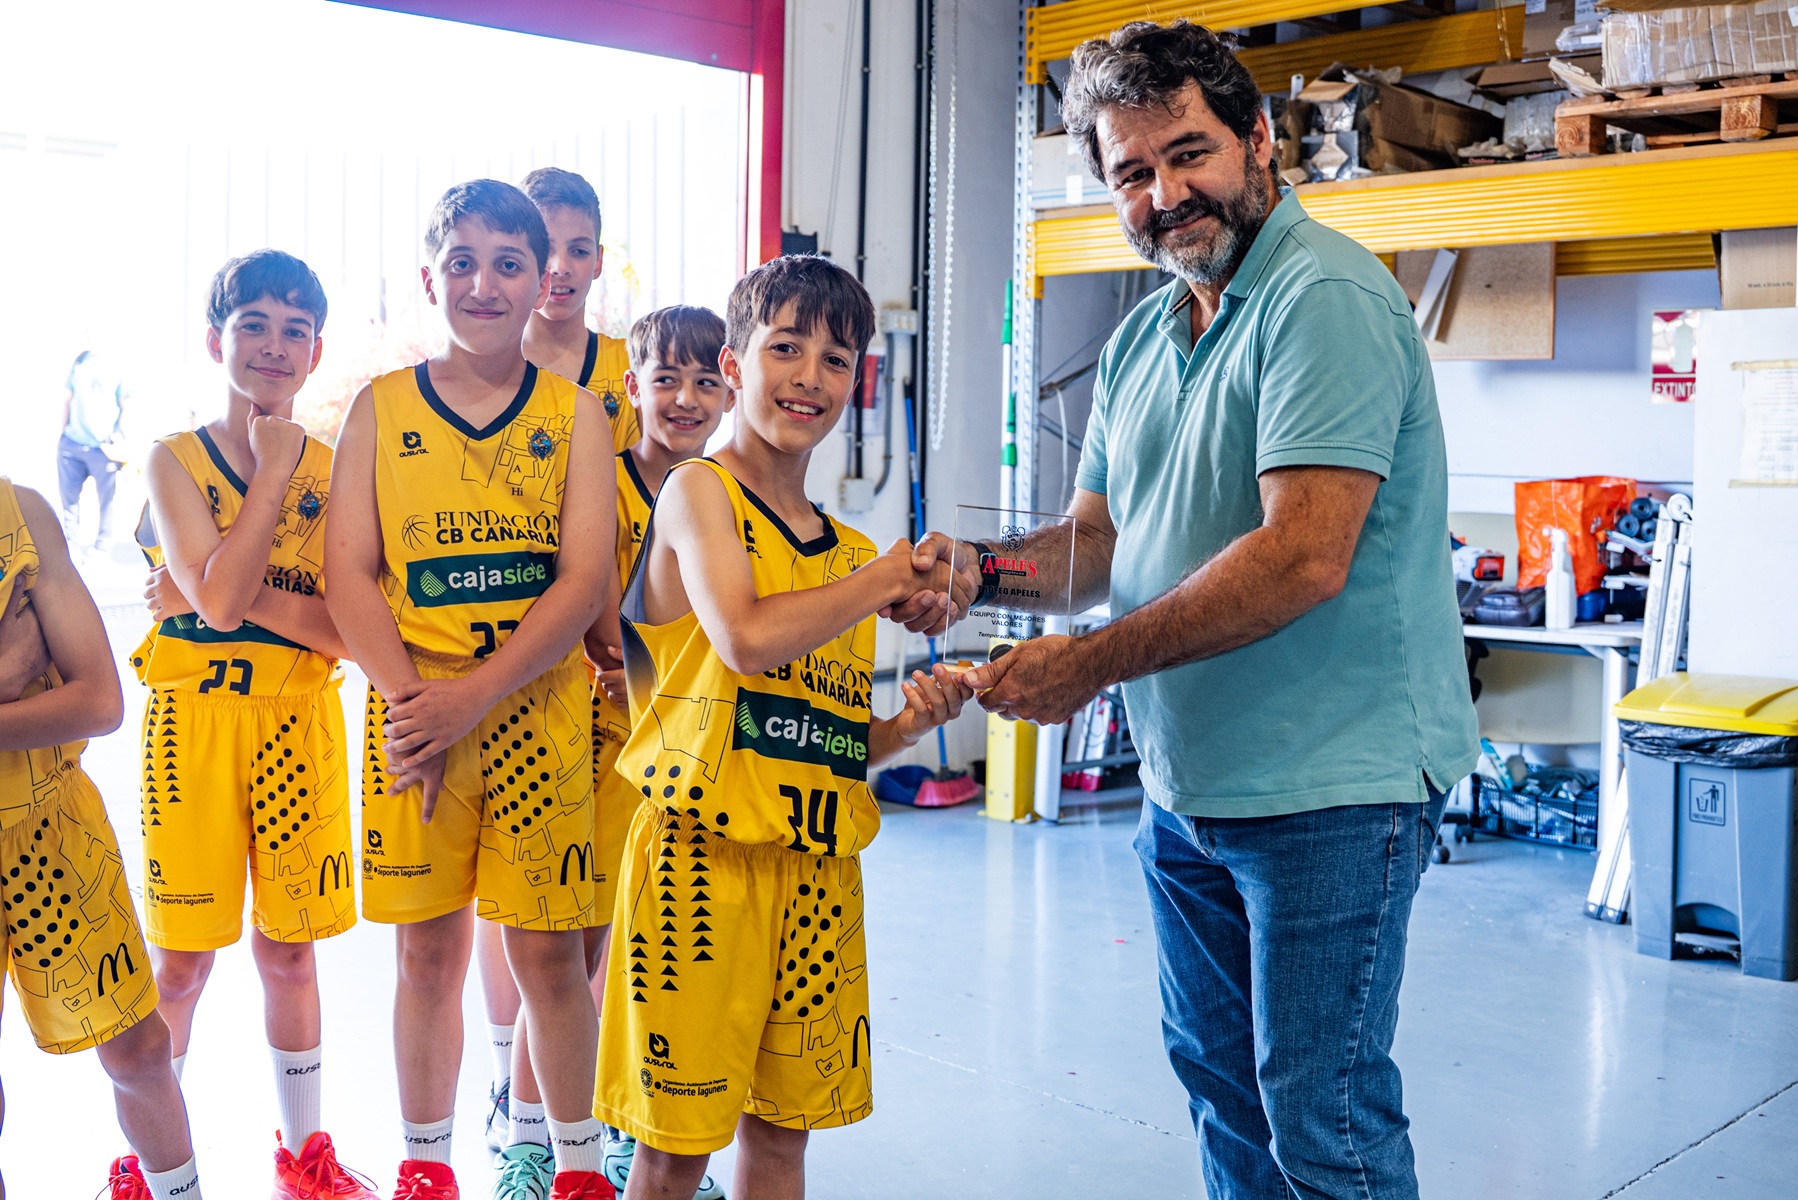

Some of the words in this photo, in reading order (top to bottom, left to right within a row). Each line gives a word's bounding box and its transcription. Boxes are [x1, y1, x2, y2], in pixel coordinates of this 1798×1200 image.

[513, 465, 521, 473] A
[511, 487, 523, 496] Hi
[436, 528, 464, 545] CB
[470, 526, 559, 547] CANARIA
[982, 557, 1037, 578] APELES
[977, 585, 1009, 595] TROFEO
[1010, 588, 1040, 598] APELES
[991, 620, 1023, 628] VALORES
[662, 1084, 696, 1097] deporte
[697, 1084, 728, 1097] lagunero
